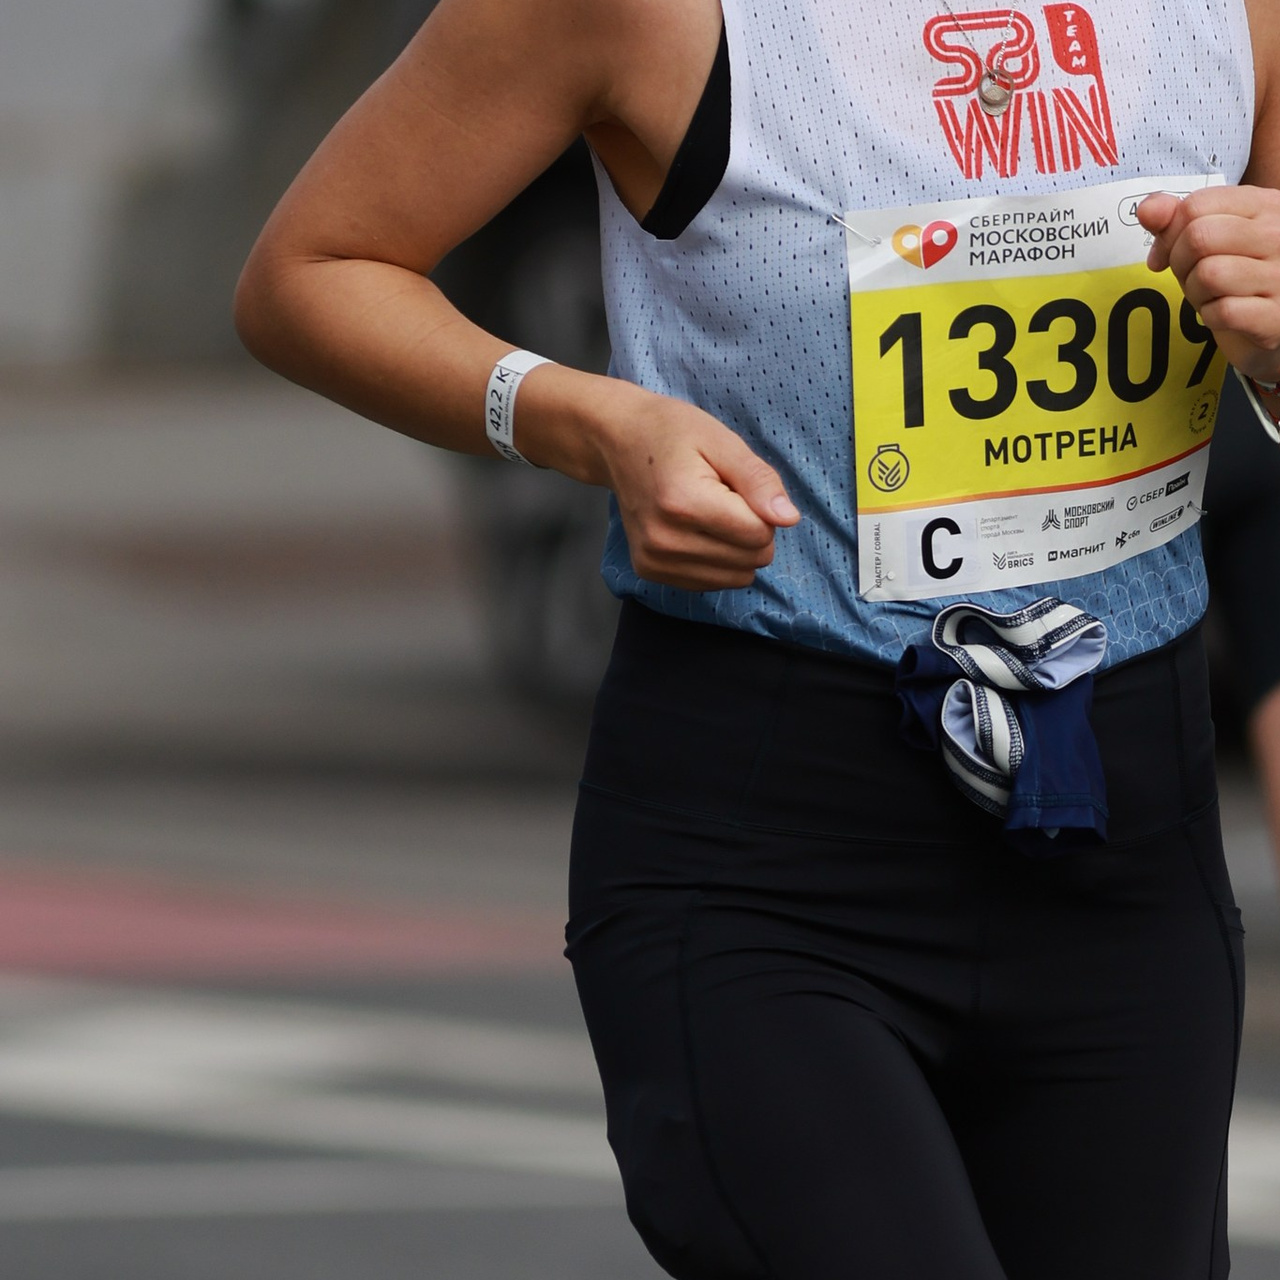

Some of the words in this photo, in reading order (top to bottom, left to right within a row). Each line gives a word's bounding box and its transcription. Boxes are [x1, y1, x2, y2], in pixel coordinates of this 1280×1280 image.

[1063, 10, 1087, 68] TEAM
[933, 84, 1119, 179] WIN
[970, 208, 1075, 228] СБЕРПРАЙМ
[970, 216, 1110, 248] МОСКОВСКИЙ
[970, 244, 1075, 266] МАРАФОН
[879, 288, 1218, 429] 13309
[490, 389, 503, 431] 42,2
[1198, 403, 1209, 420] 2
[984, 422, 1138, 466] МОТРЕНА
[1140, 487, 1165, 504] СБЕР
[1064, 497, 1115, 518] МОСКОВСКИЙ
[1064, 516, 1089, 529] СПОРТ
[874, 522, 882, 551] CORRAL
[1060, 542, 1106, 559] магнит
[1007, 557, 1034, 569] BRICS
